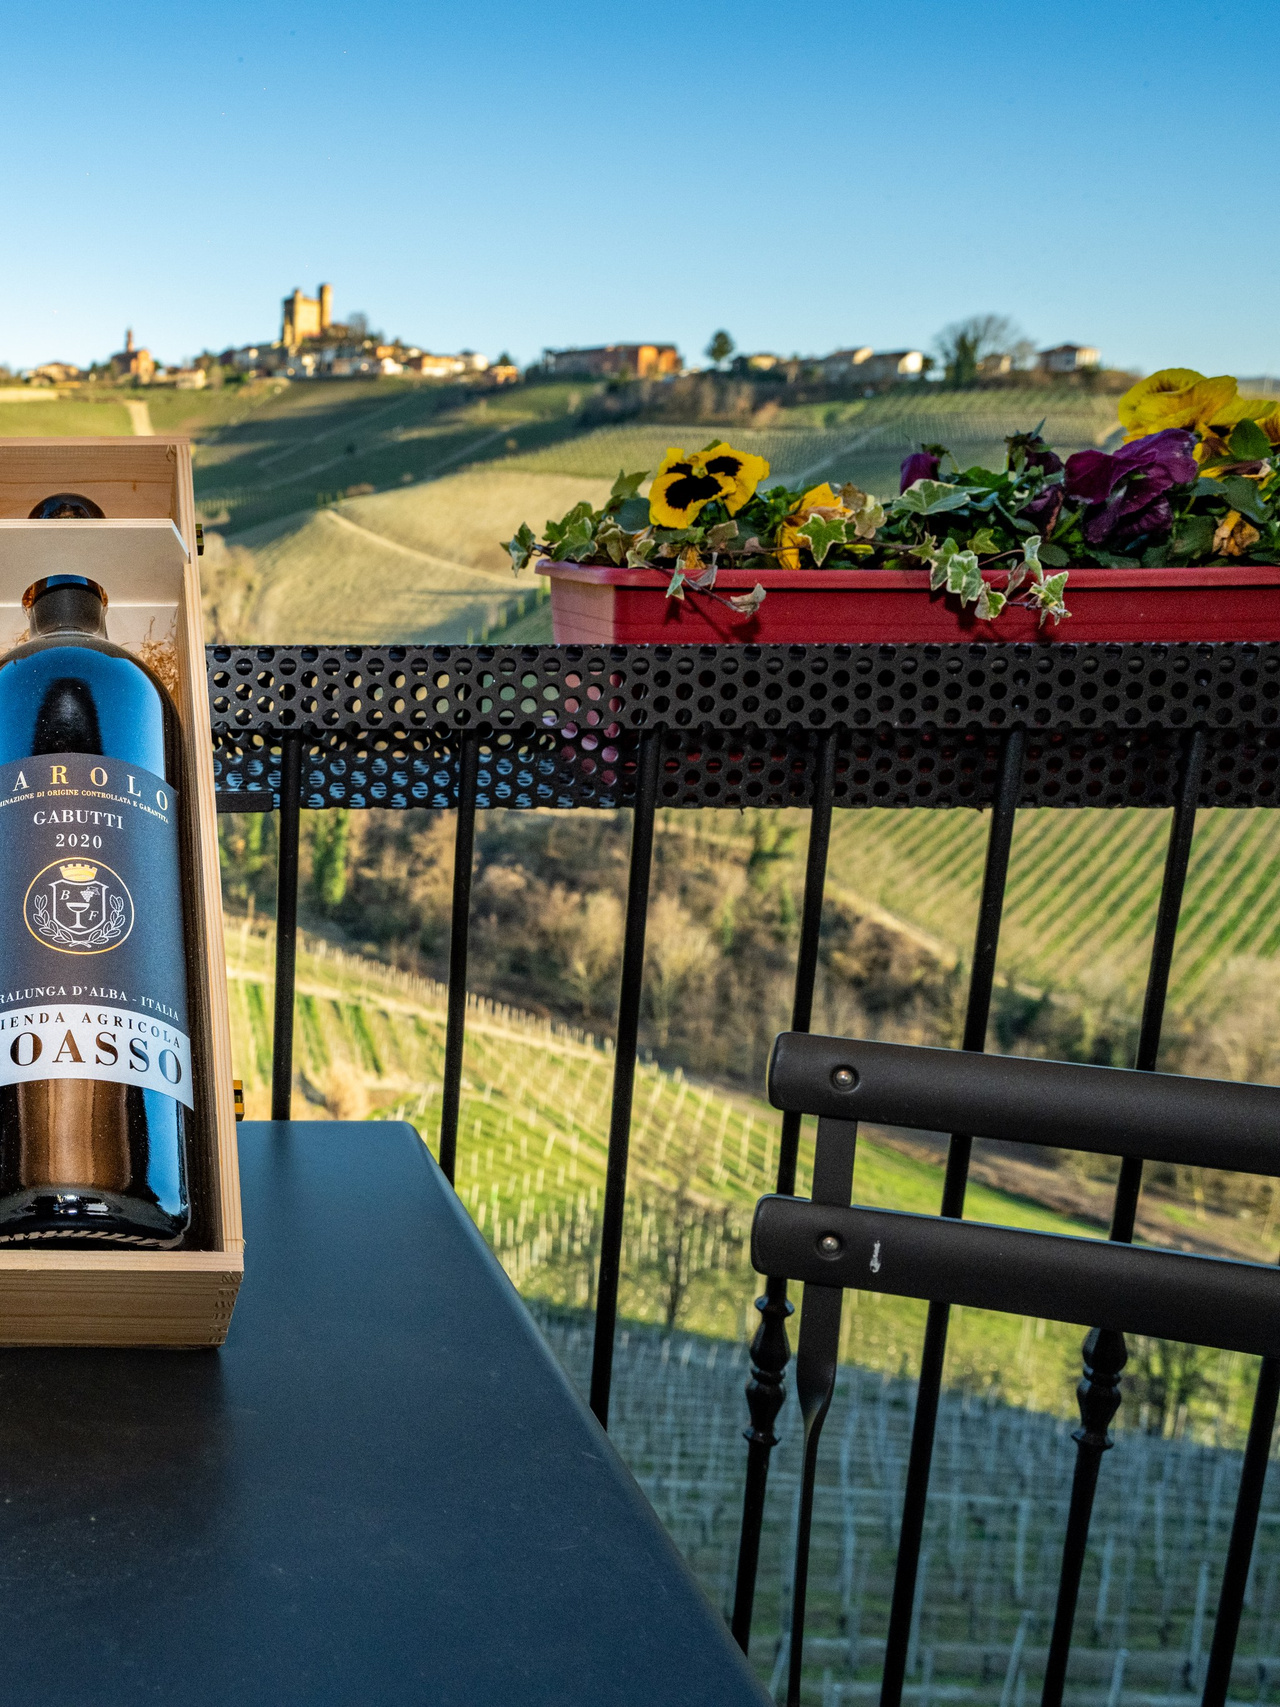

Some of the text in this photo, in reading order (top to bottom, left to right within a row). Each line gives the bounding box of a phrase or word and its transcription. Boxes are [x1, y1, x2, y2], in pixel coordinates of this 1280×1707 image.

[36, 790, 45, 798] DI
[47, 789, 79, 797] ORIGINE
[81, 790, 131, 805] CONTROLLATA
[139, 803, 169, 824] GARANTITA
[33, 809, 124, 830] GABUTTI
[55, 833, 103, 849] 2020
[60, 889, 71, 901] B
[88, 910, 99, 921] F
[141, 996, 180, 1022] ITALIA
[81, 1012, 181, 1049] AGRICOLA
